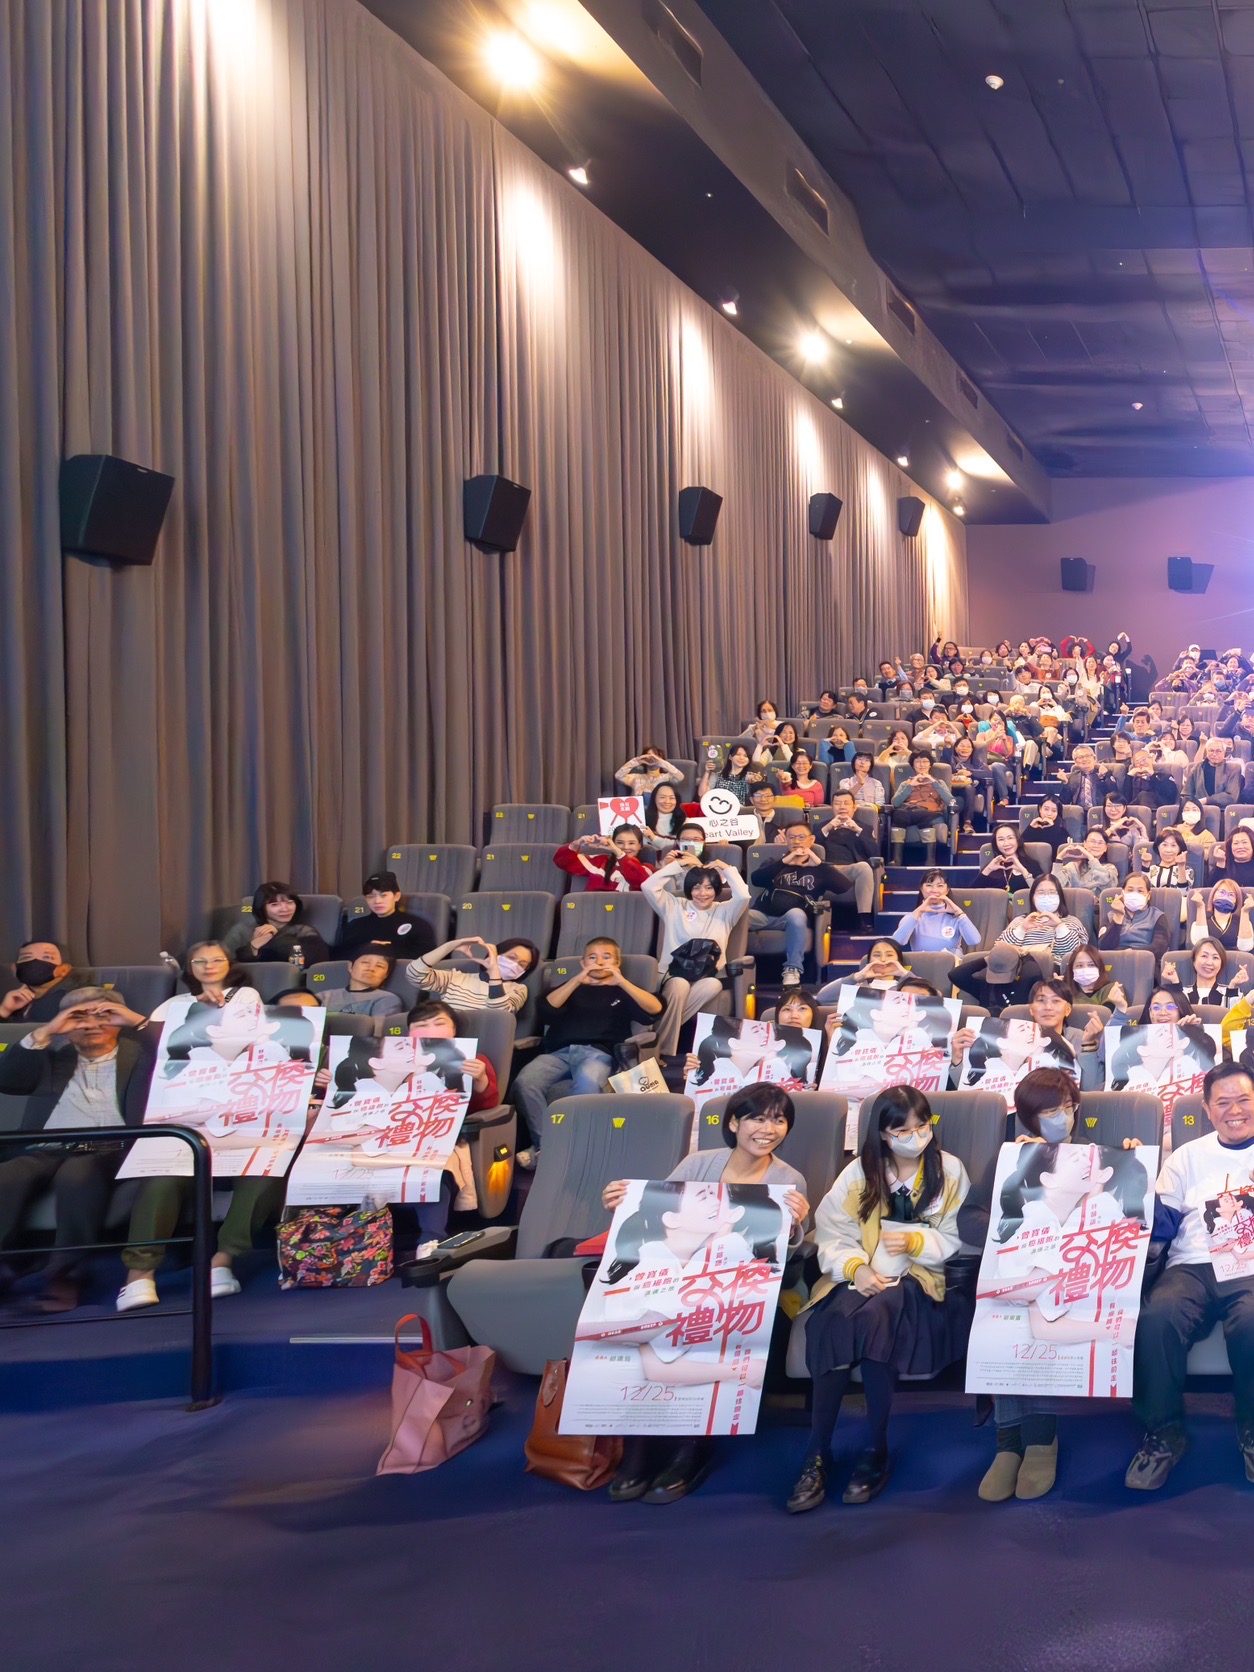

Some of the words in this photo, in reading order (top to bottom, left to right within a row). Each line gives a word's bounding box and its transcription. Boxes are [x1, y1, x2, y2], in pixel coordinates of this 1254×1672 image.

[708, 818, 738, 828] 心之谷
[705, 830, 722, 838] eart
[725, 829, 754, 837] Valley
[313, 974, 325, 982] 20
[884, 1048, 944, 1076] 交換
[388, 1089, 461, 1121] 交換
[551, 1114, 565, 1124] 17
[706, 1115, 720, 1125] 16
[1182, 1115, 1195, 1125] 13
[376, 1117, 455, 1149] 禮物
[1060, 1217, 1142, 1263] 交換
[678, 1257, 770, 1306] 交換
[1049, 1255, 1135, 1306] 禮物
[665, 1298, 766, 1347] 禮物
[1012, 1344, 1058, 1360] 12/25
[620, 1385, 676, 1401] 12/25
